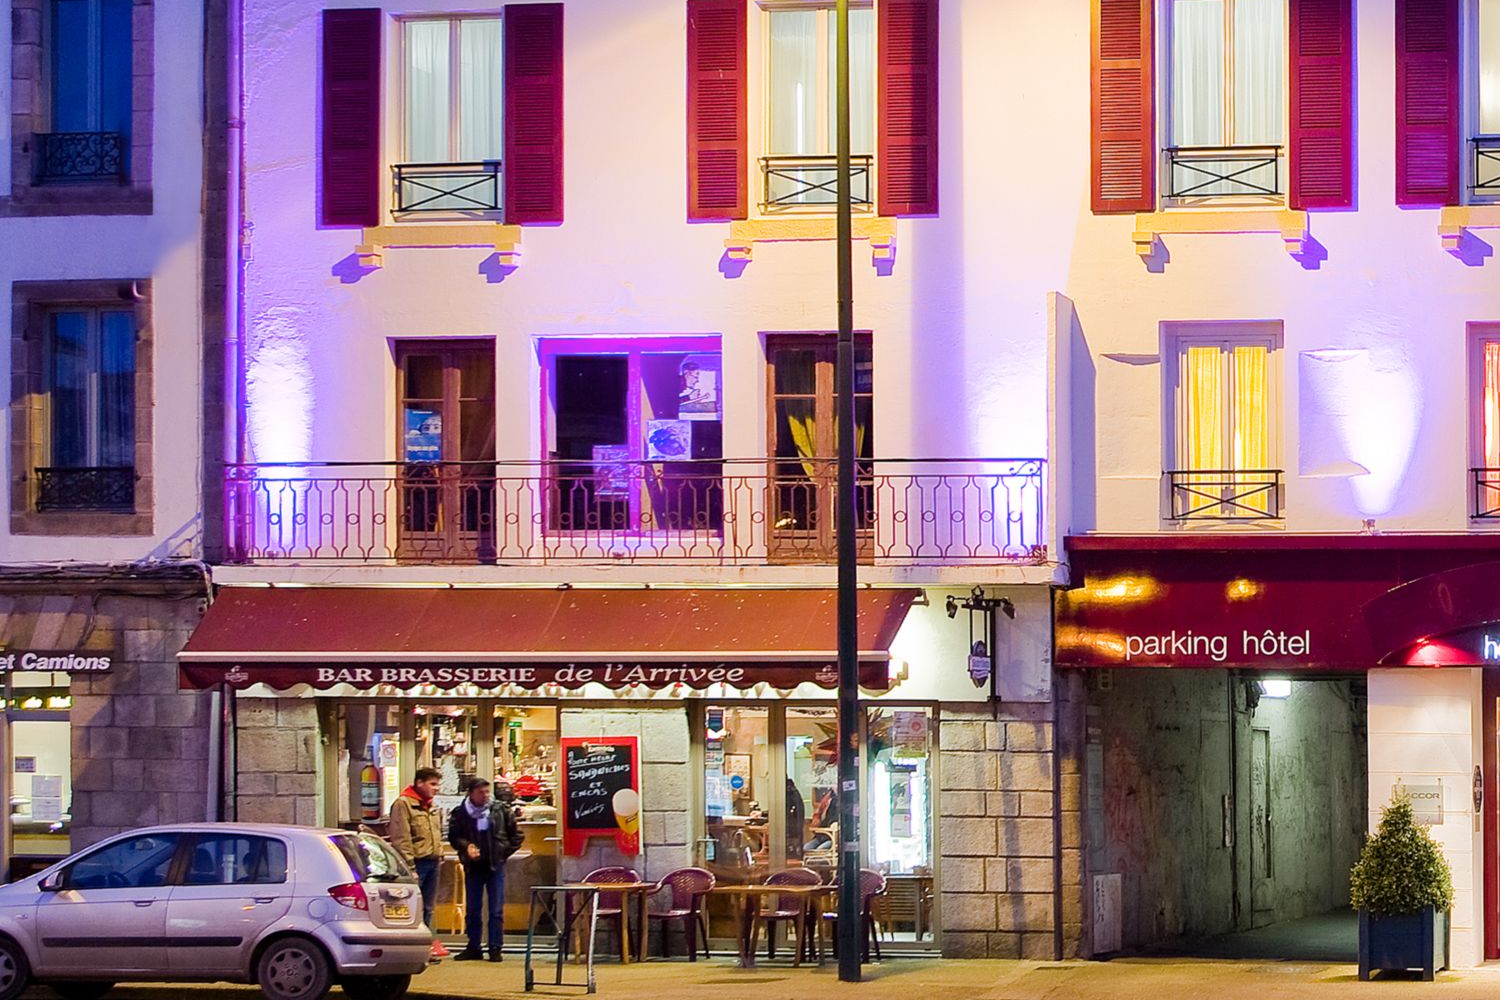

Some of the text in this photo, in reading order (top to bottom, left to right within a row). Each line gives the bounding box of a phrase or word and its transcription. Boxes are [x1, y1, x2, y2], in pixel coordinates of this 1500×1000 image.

[1125, 629, 1310, 662] parking hôtel
[21, 652, 111, 670] Camions
[317, 667, 373, 682] BAR
[380, 667, 536, 682] BRASSERIE
[554, 664, 593, 682] de
